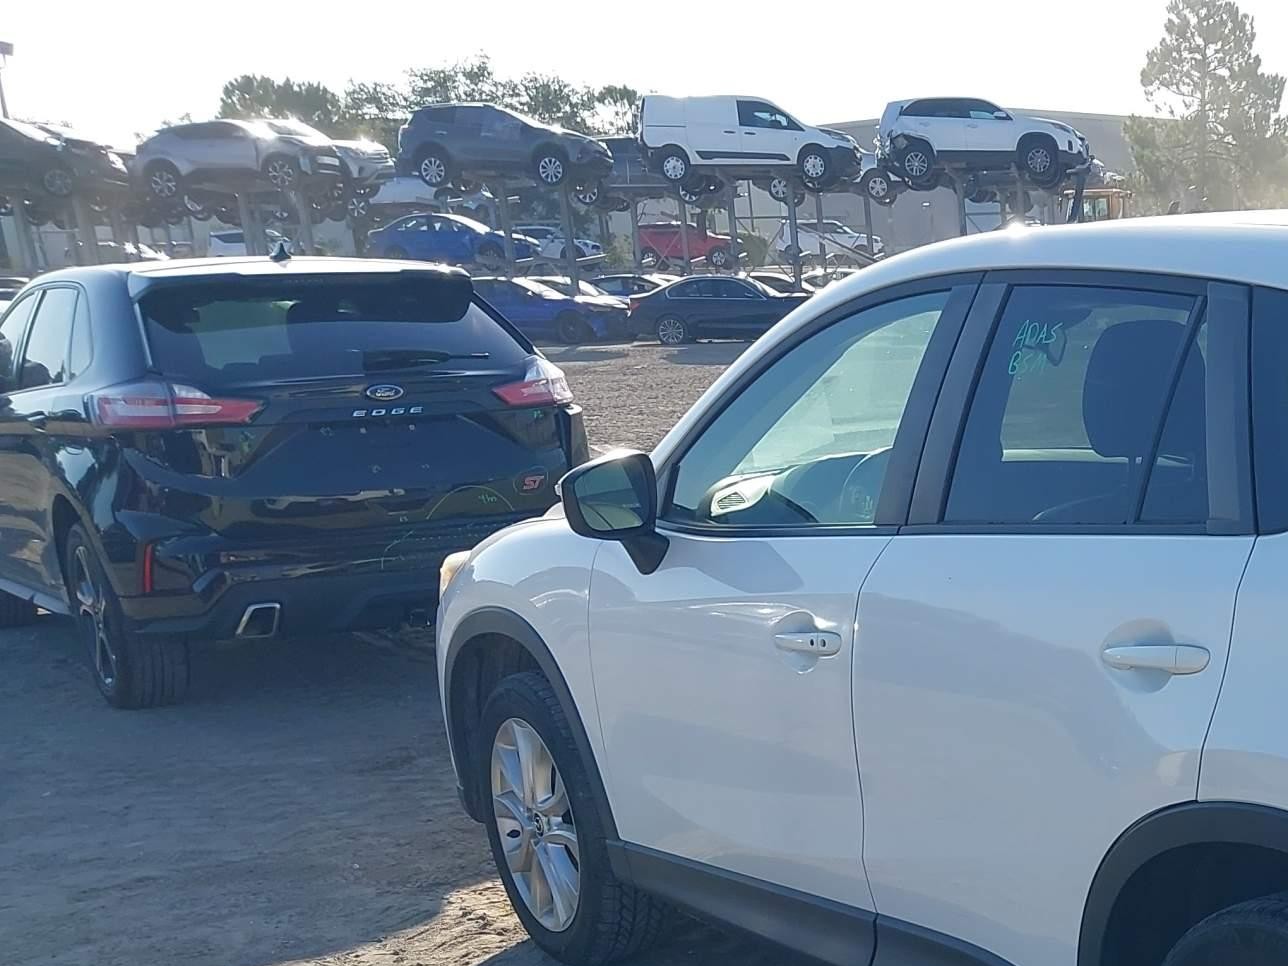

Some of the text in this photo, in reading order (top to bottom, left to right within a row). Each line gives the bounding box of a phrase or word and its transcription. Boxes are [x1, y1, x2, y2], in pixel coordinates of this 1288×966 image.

[1012, 320, 1063, 347] ADAS
[352, 406, 424, 417] EDGE
[522, 475, 544, 490] ST
